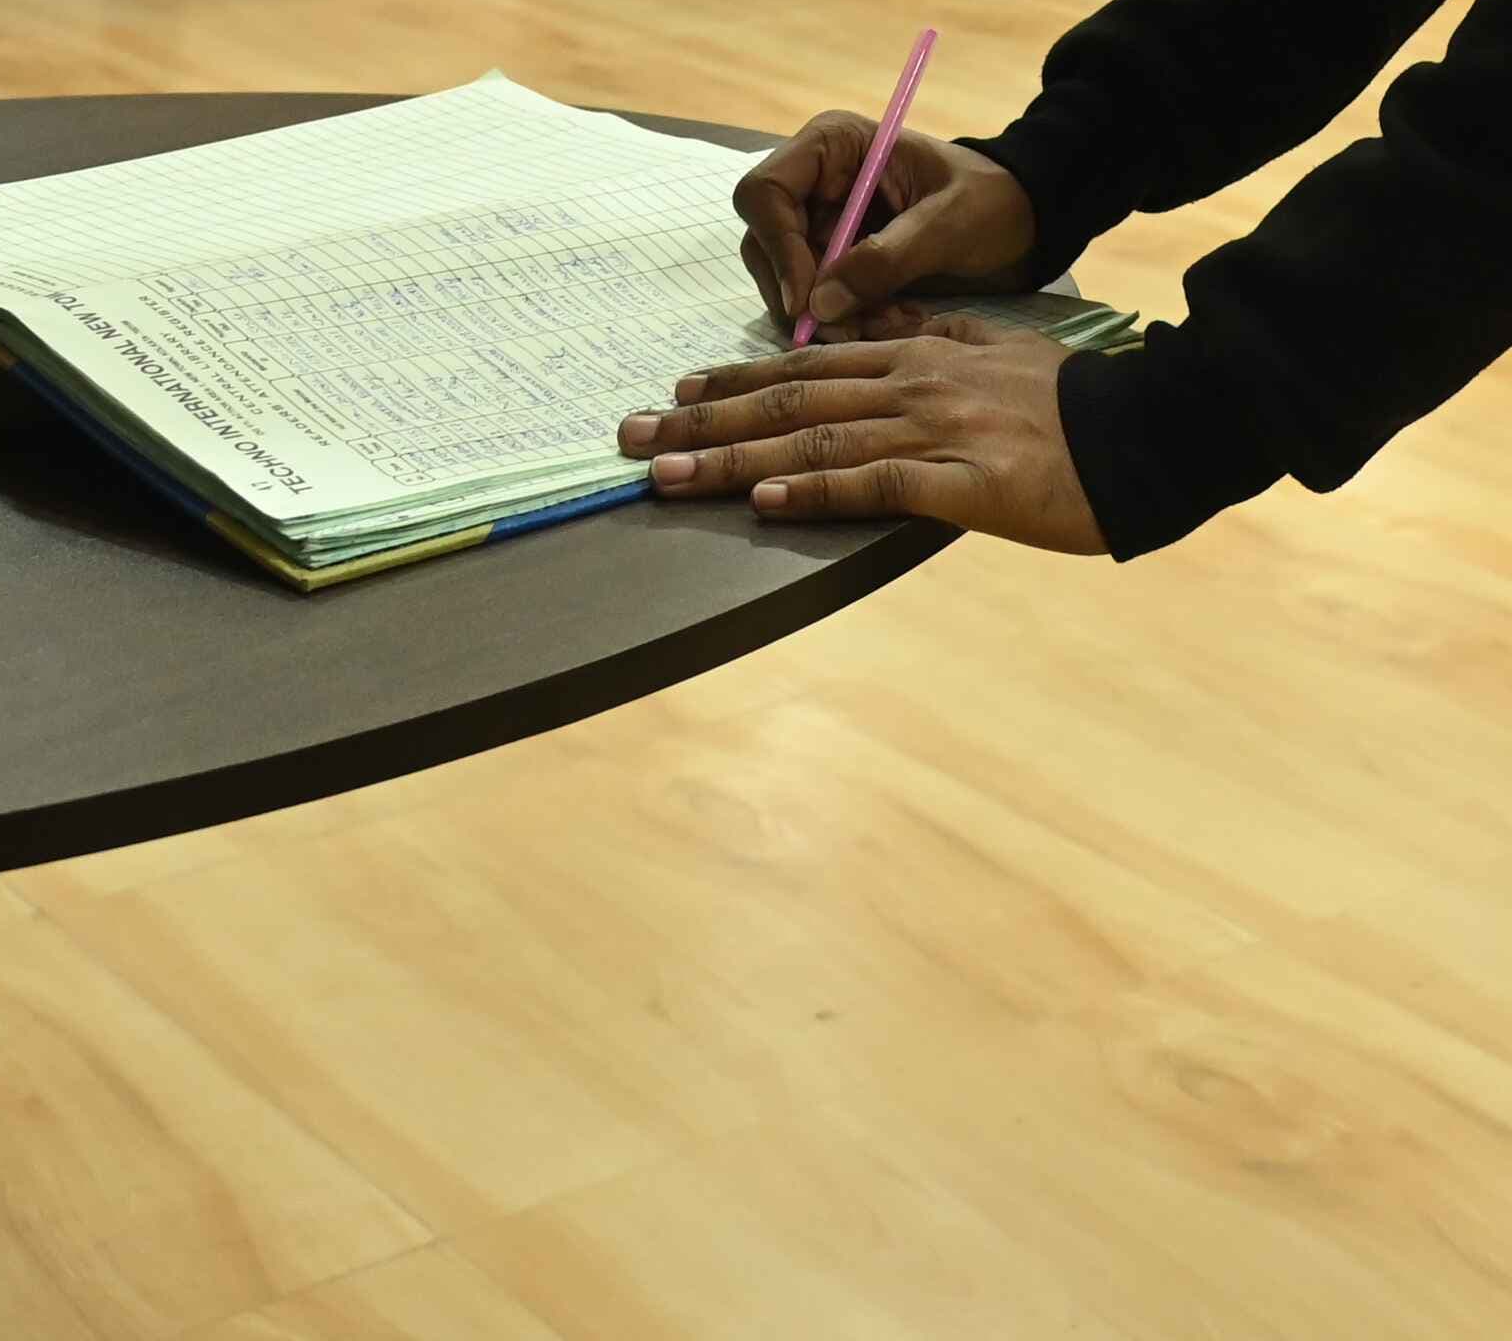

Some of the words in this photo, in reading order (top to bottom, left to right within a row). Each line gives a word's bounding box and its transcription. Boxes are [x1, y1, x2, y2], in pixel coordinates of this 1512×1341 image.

[73, 312, 123, 340] NEW
[138, 295, 197, 338] REGISTER
[160, 331, 211, 371] LIBRARY
[193, 338, 271, 399] ATTENDANCE
[113, 339, 243, 440] INTERNATIONAL
[210, 372, 264, 416] CENTRAL
[234, 440, 313, 495] TECHNO
